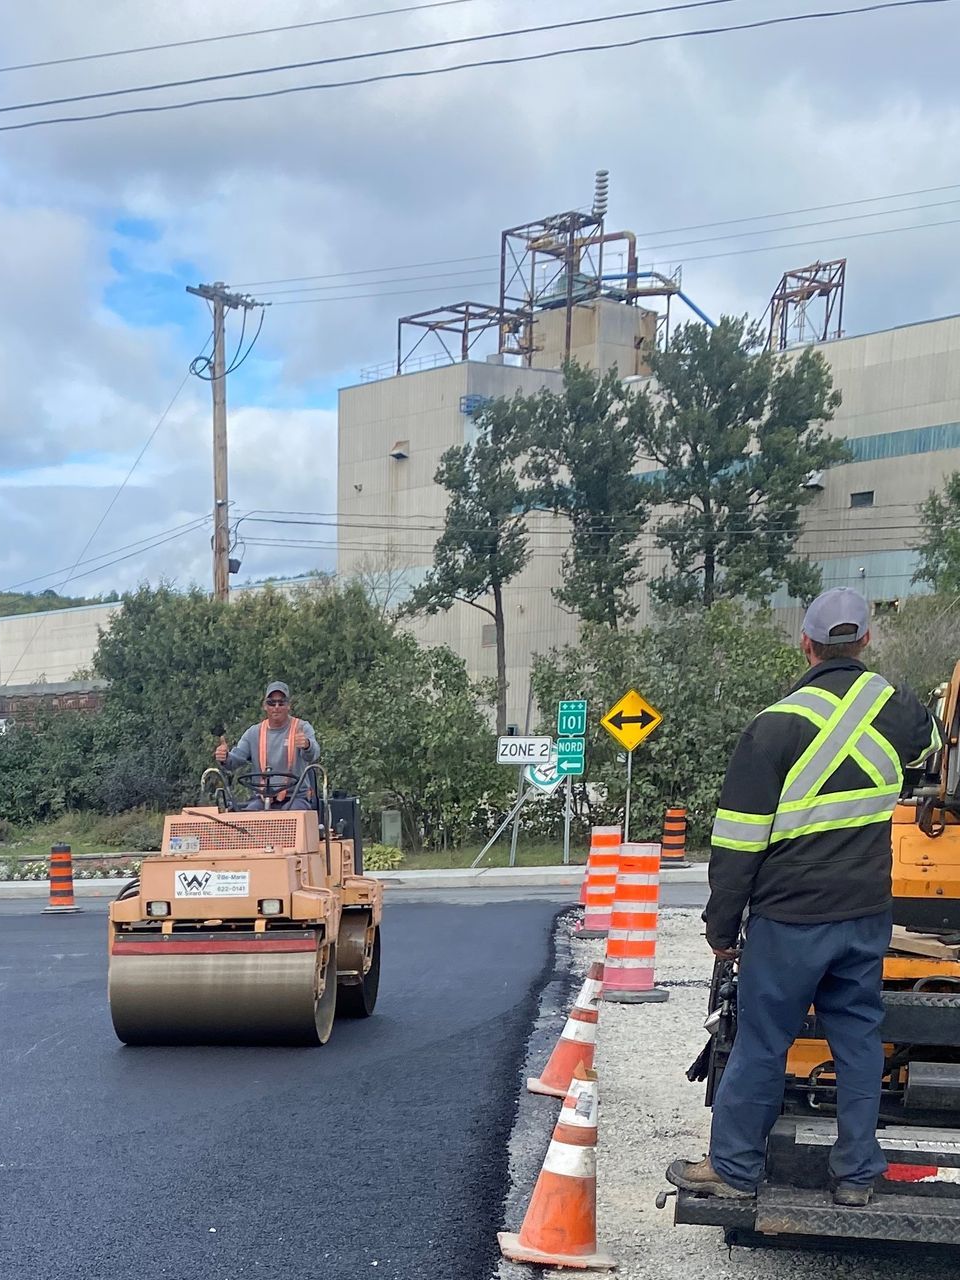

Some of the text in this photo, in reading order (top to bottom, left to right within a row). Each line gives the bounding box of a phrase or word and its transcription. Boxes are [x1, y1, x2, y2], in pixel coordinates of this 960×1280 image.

[562, 715, 582, 730] 101
[500, 743, 549, 757] ZONE 2
[559, 742, 583, 752] NORD
